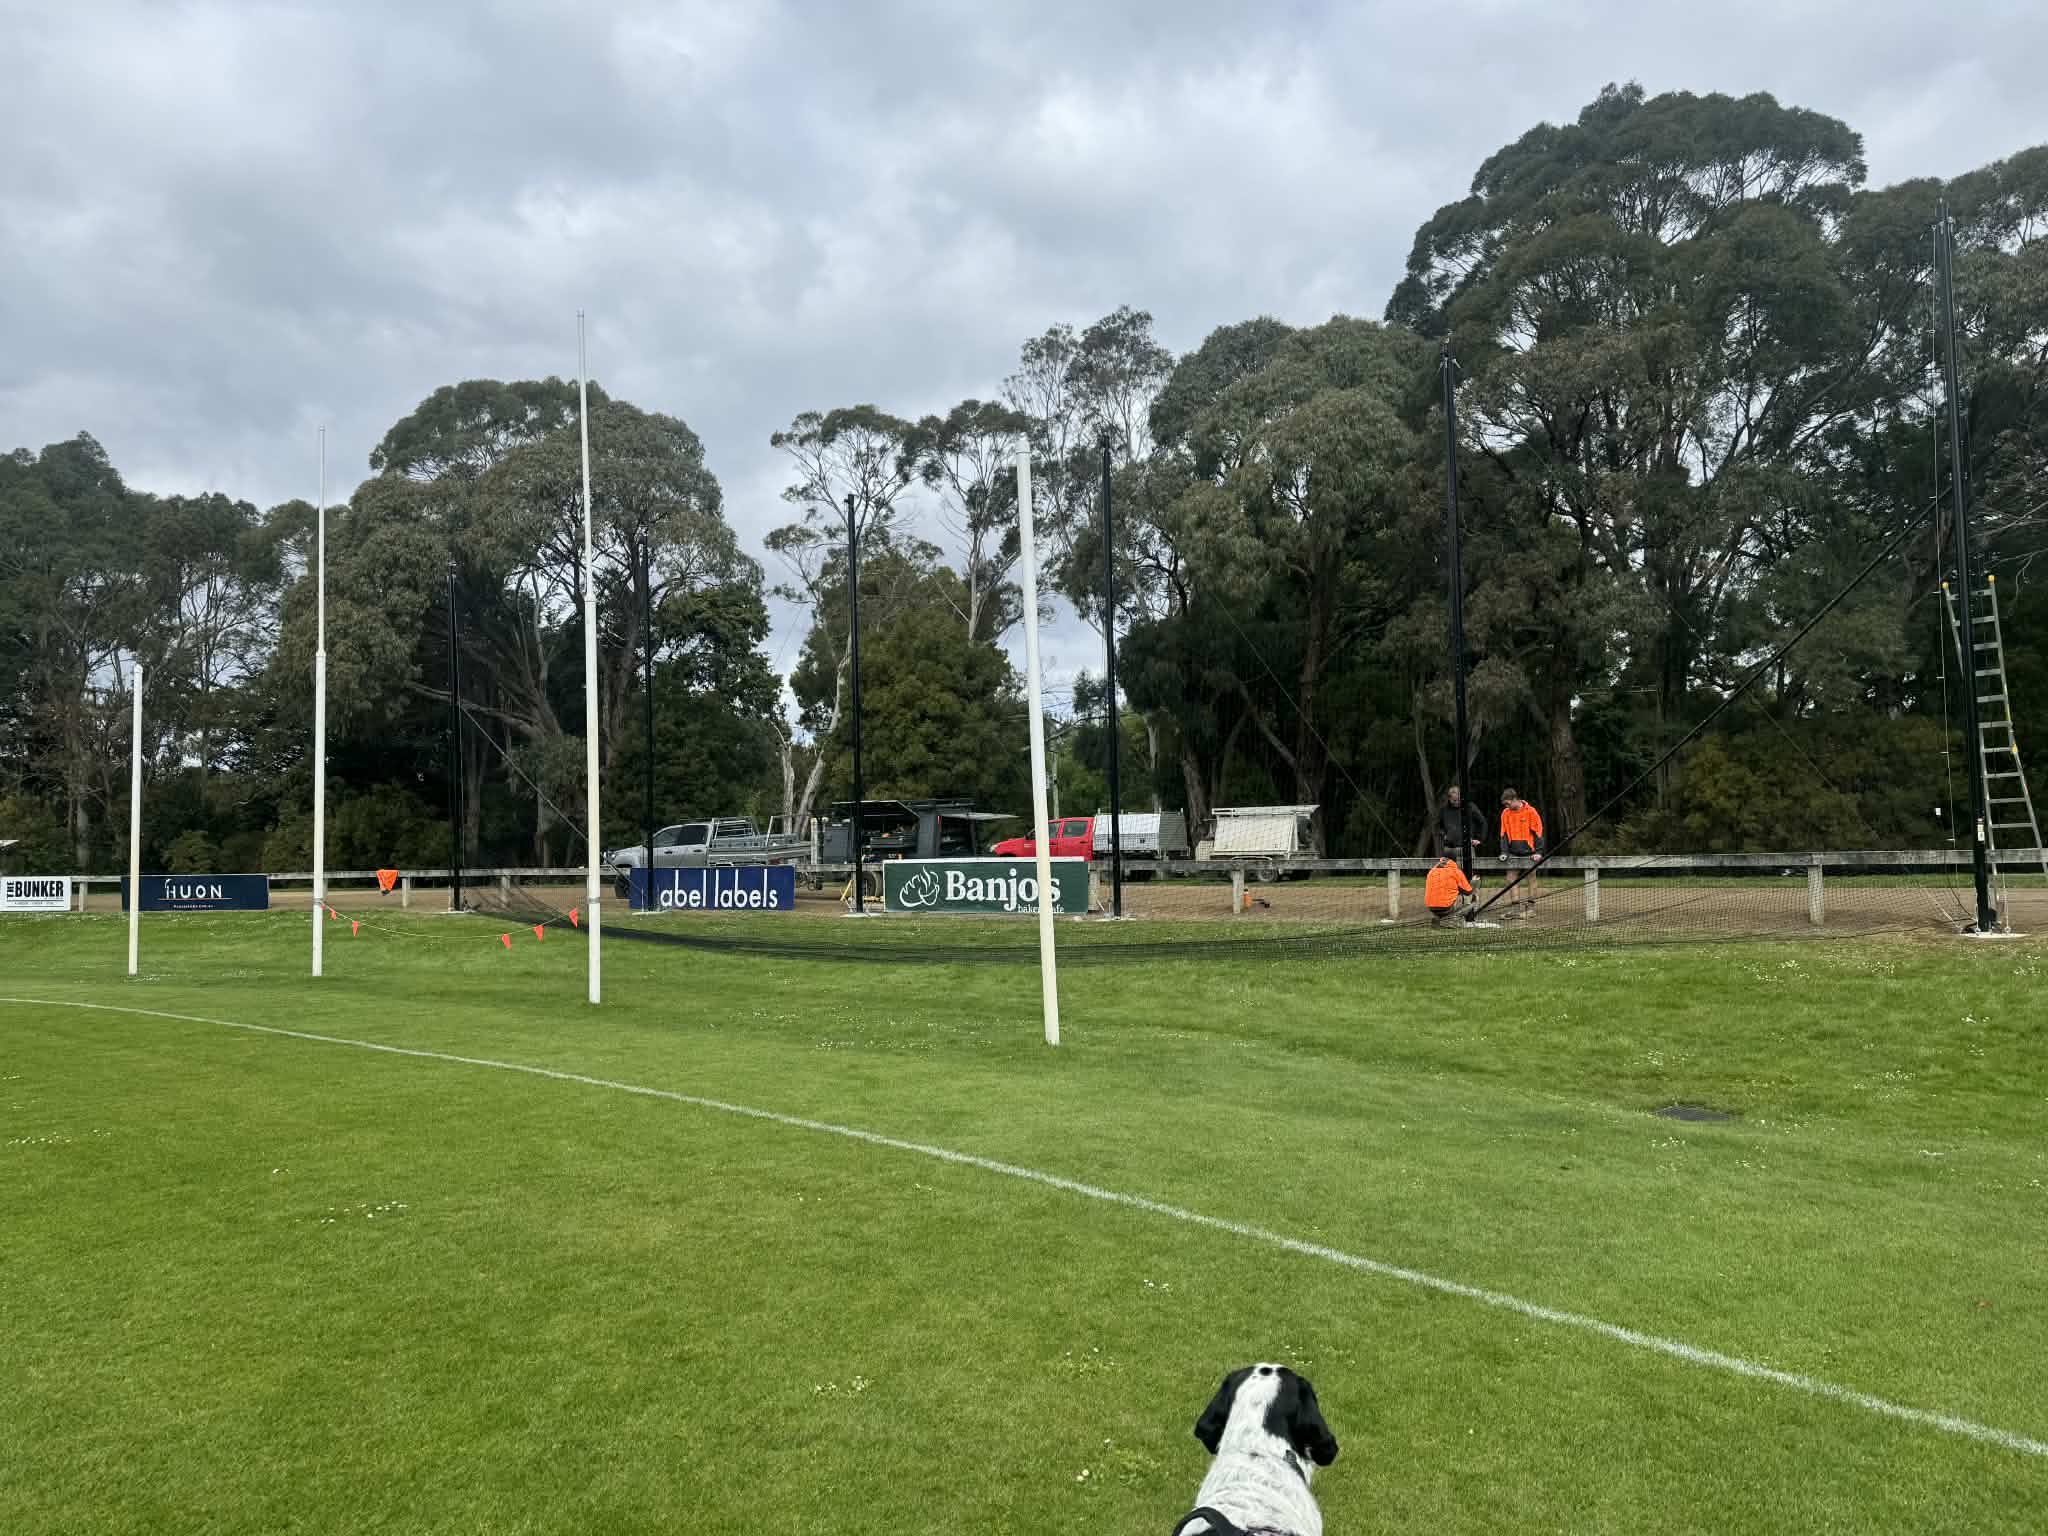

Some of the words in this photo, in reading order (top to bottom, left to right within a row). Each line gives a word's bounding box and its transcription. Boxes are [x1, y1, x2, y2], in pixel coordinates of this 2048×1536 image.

[15, 881, 64, 897] BUNKER
[165, 883, 222, 899] HUON
[660, 869, 706, 908] abel
[714, 869, 778, 908] labels
